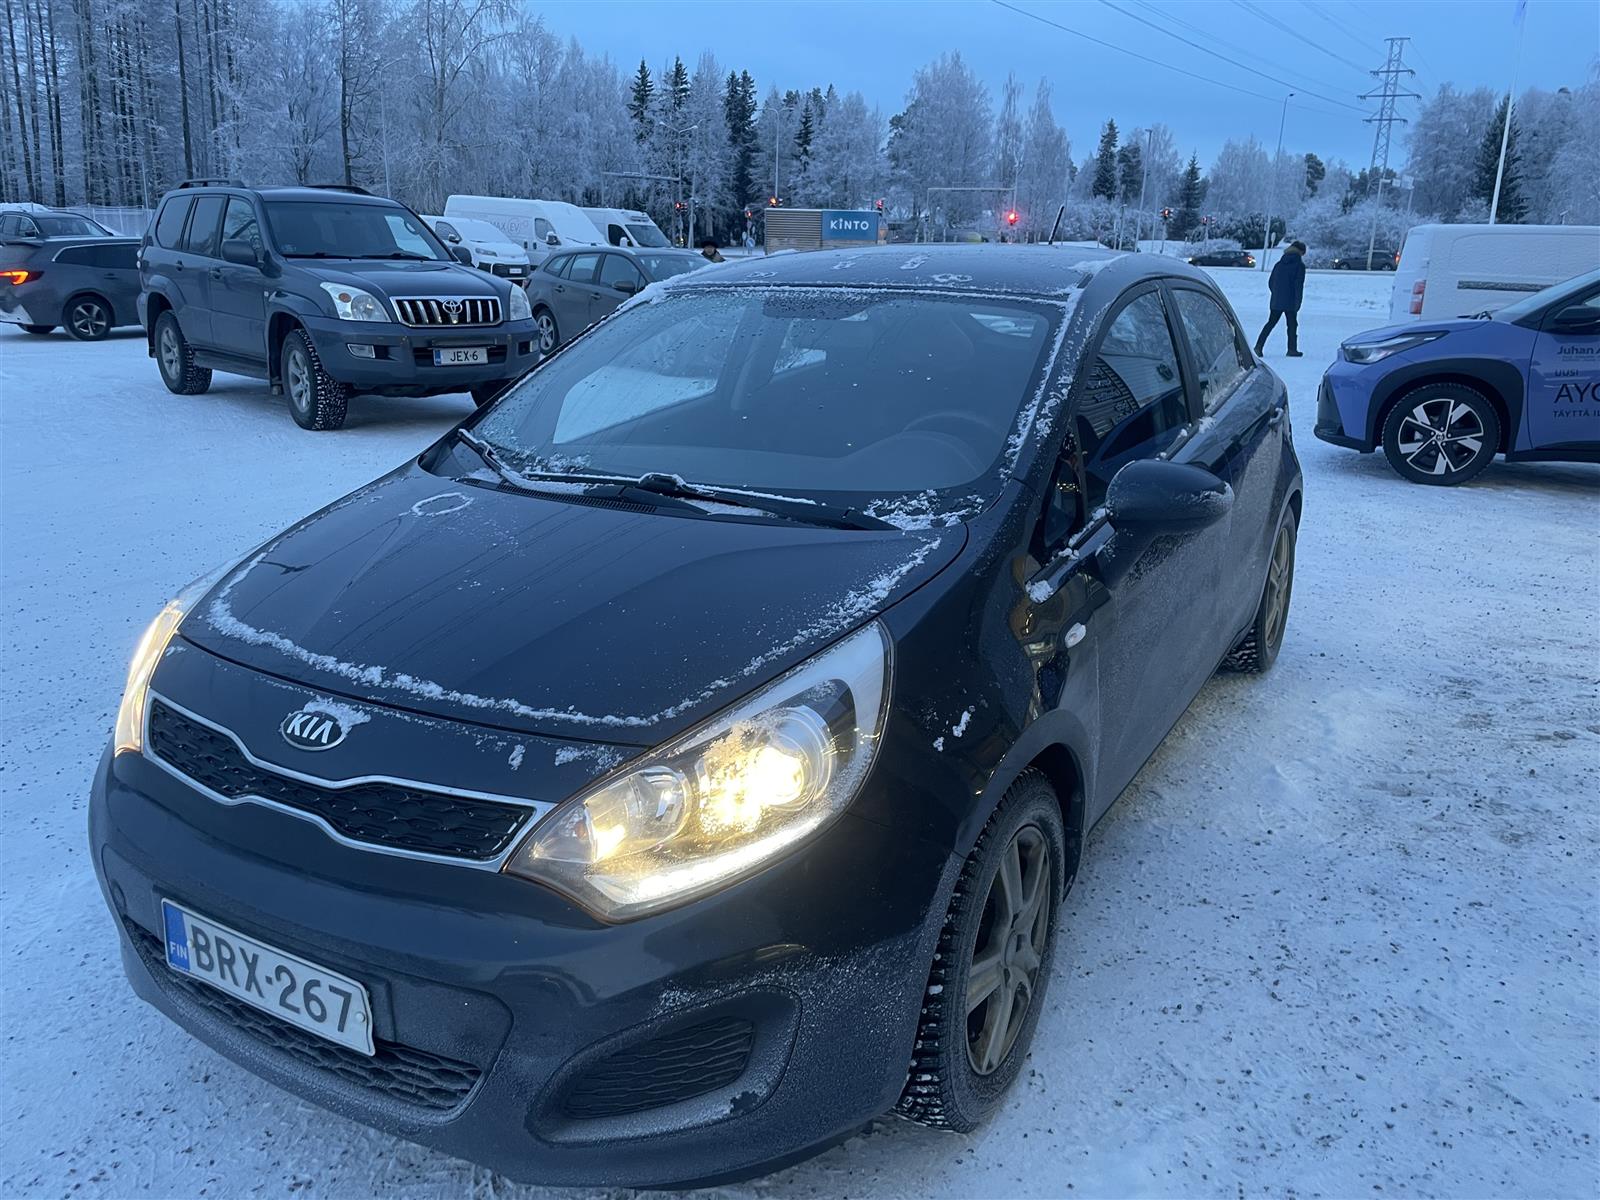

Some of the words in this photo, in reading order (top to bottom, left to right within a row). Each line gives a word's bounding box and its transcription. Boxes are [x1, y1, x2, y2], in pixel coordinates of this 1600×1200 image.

[450, 350, 479, 362] JEX-6
[1557, 345, 1593, 355] Juhan
[286, 713, 333, 744] KIA
[169, 942, 188, 960] FIN
[190, 924, 352, 1033] BRX-267
